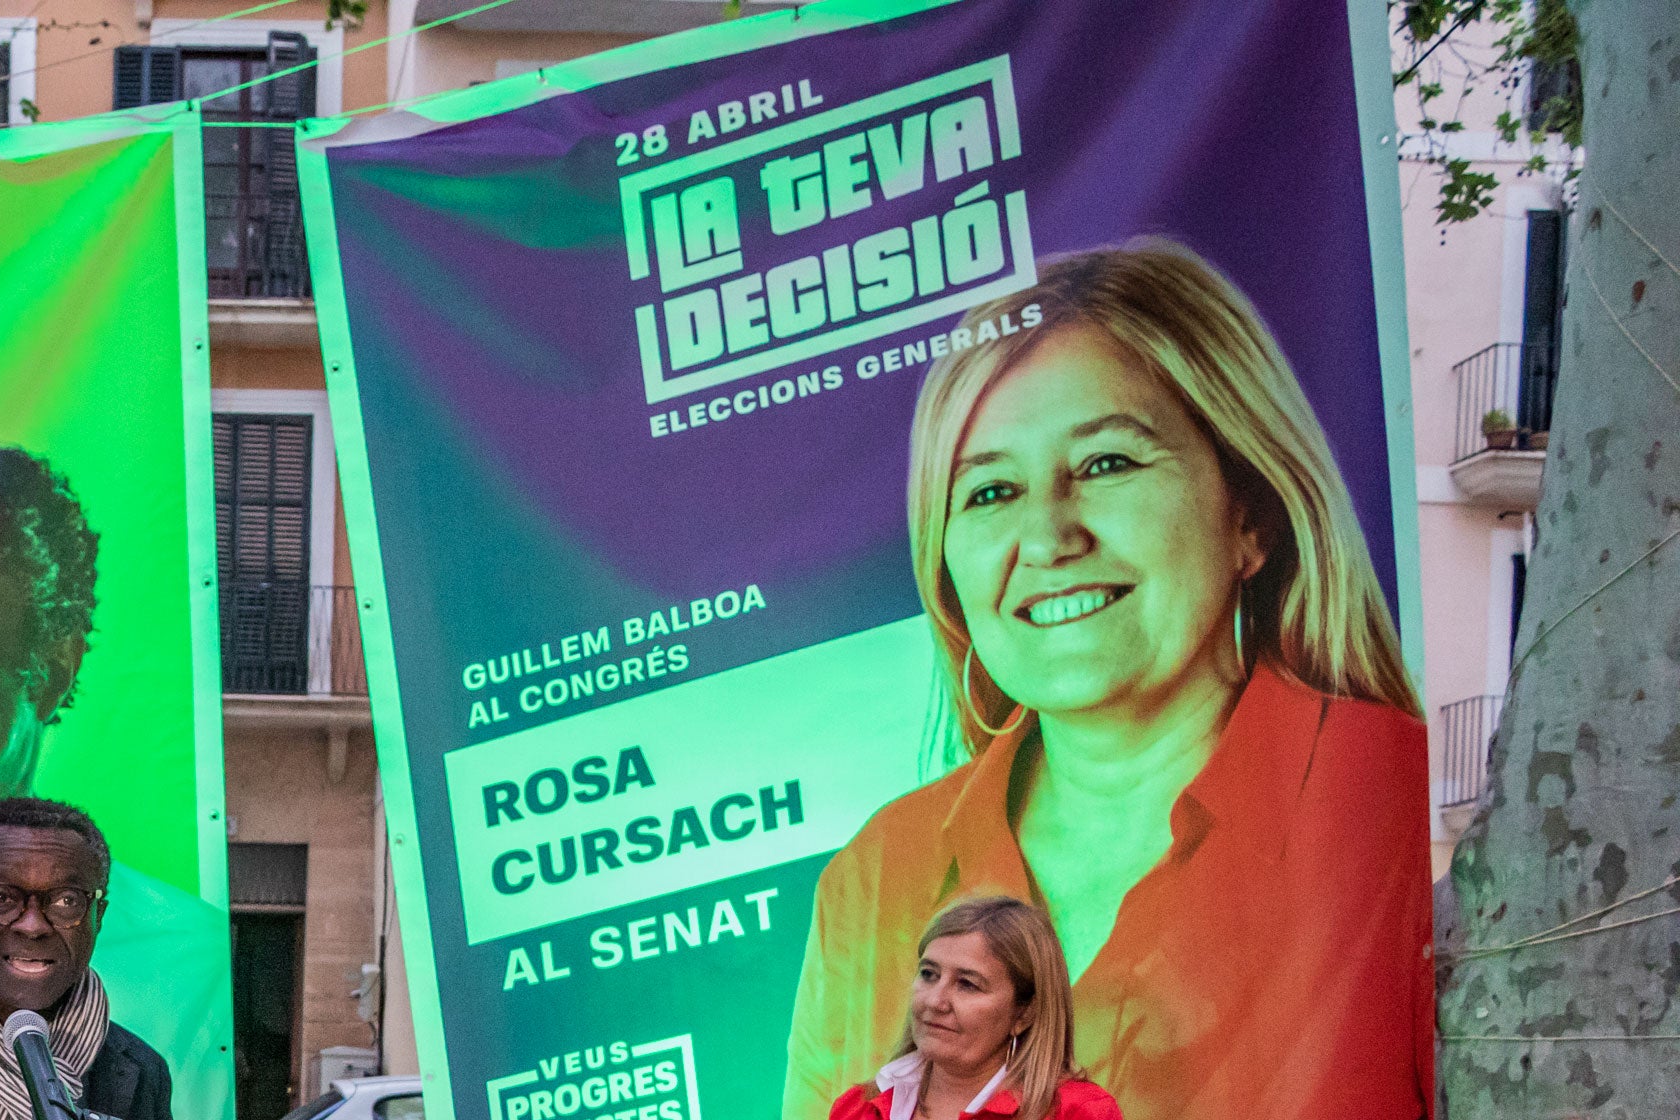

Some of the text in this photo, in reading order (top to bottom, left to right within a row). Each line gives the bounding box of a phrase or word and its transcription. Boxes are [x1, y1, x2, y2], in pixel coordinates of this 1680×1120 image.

[615, 78, 823, 166] 28 ABRIL
[651, 96, 994, 293] LA TEVA
[663, 180, 1005, 371] DECISIÓ
[649, 303, 1044, 438] ELECCIONS GENERALS
[462, 584, 766, 691] GUILLEM BALBOA
[468, 645, 690, 729] AL CONGRÉS
[482, 745, 656, 828] ROSA
[491, 779, 805, 895] CURSACH
[503, 888, 779, 991] AL SENAT
[538, 1041, 629, 1081] VEUS
